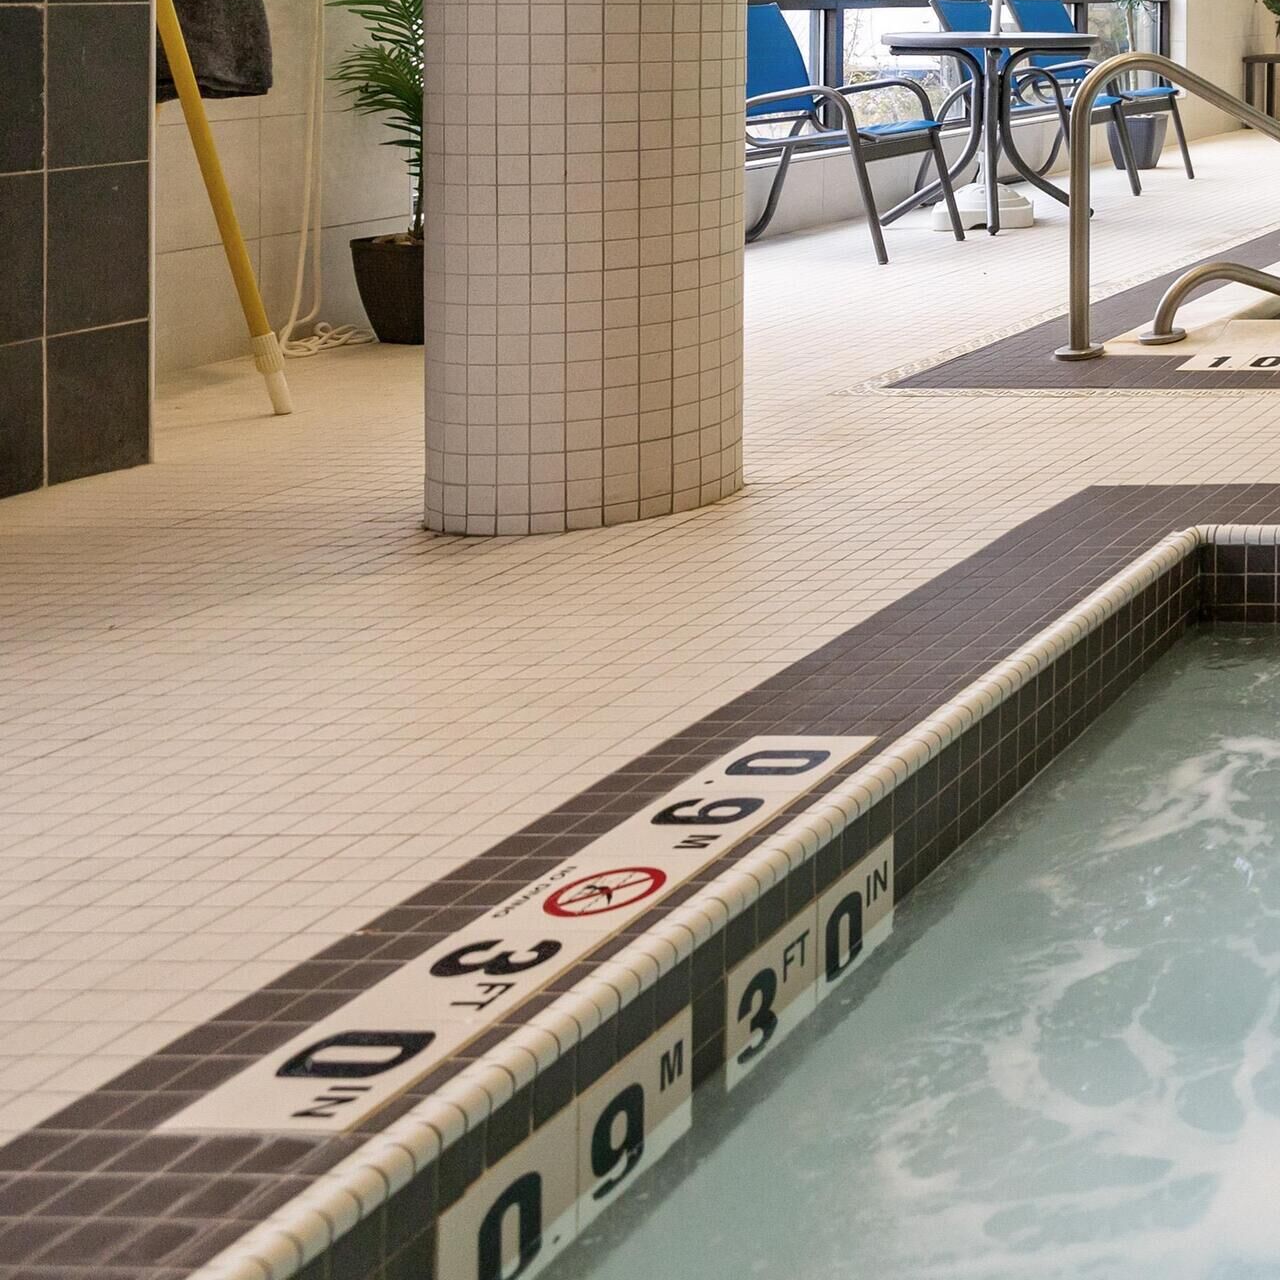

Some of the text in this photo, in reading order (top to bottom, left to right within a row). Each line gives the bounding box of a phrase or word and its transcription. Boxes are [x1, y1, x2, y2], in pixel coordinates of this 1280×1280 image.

[672, 834, 722, 849] M
[737, 860, 888, 1065] 3 FT 0 IN
[275, 938, 563, 1118] 3 FT 0 IN
[660, 1039, 684, 1093] M
